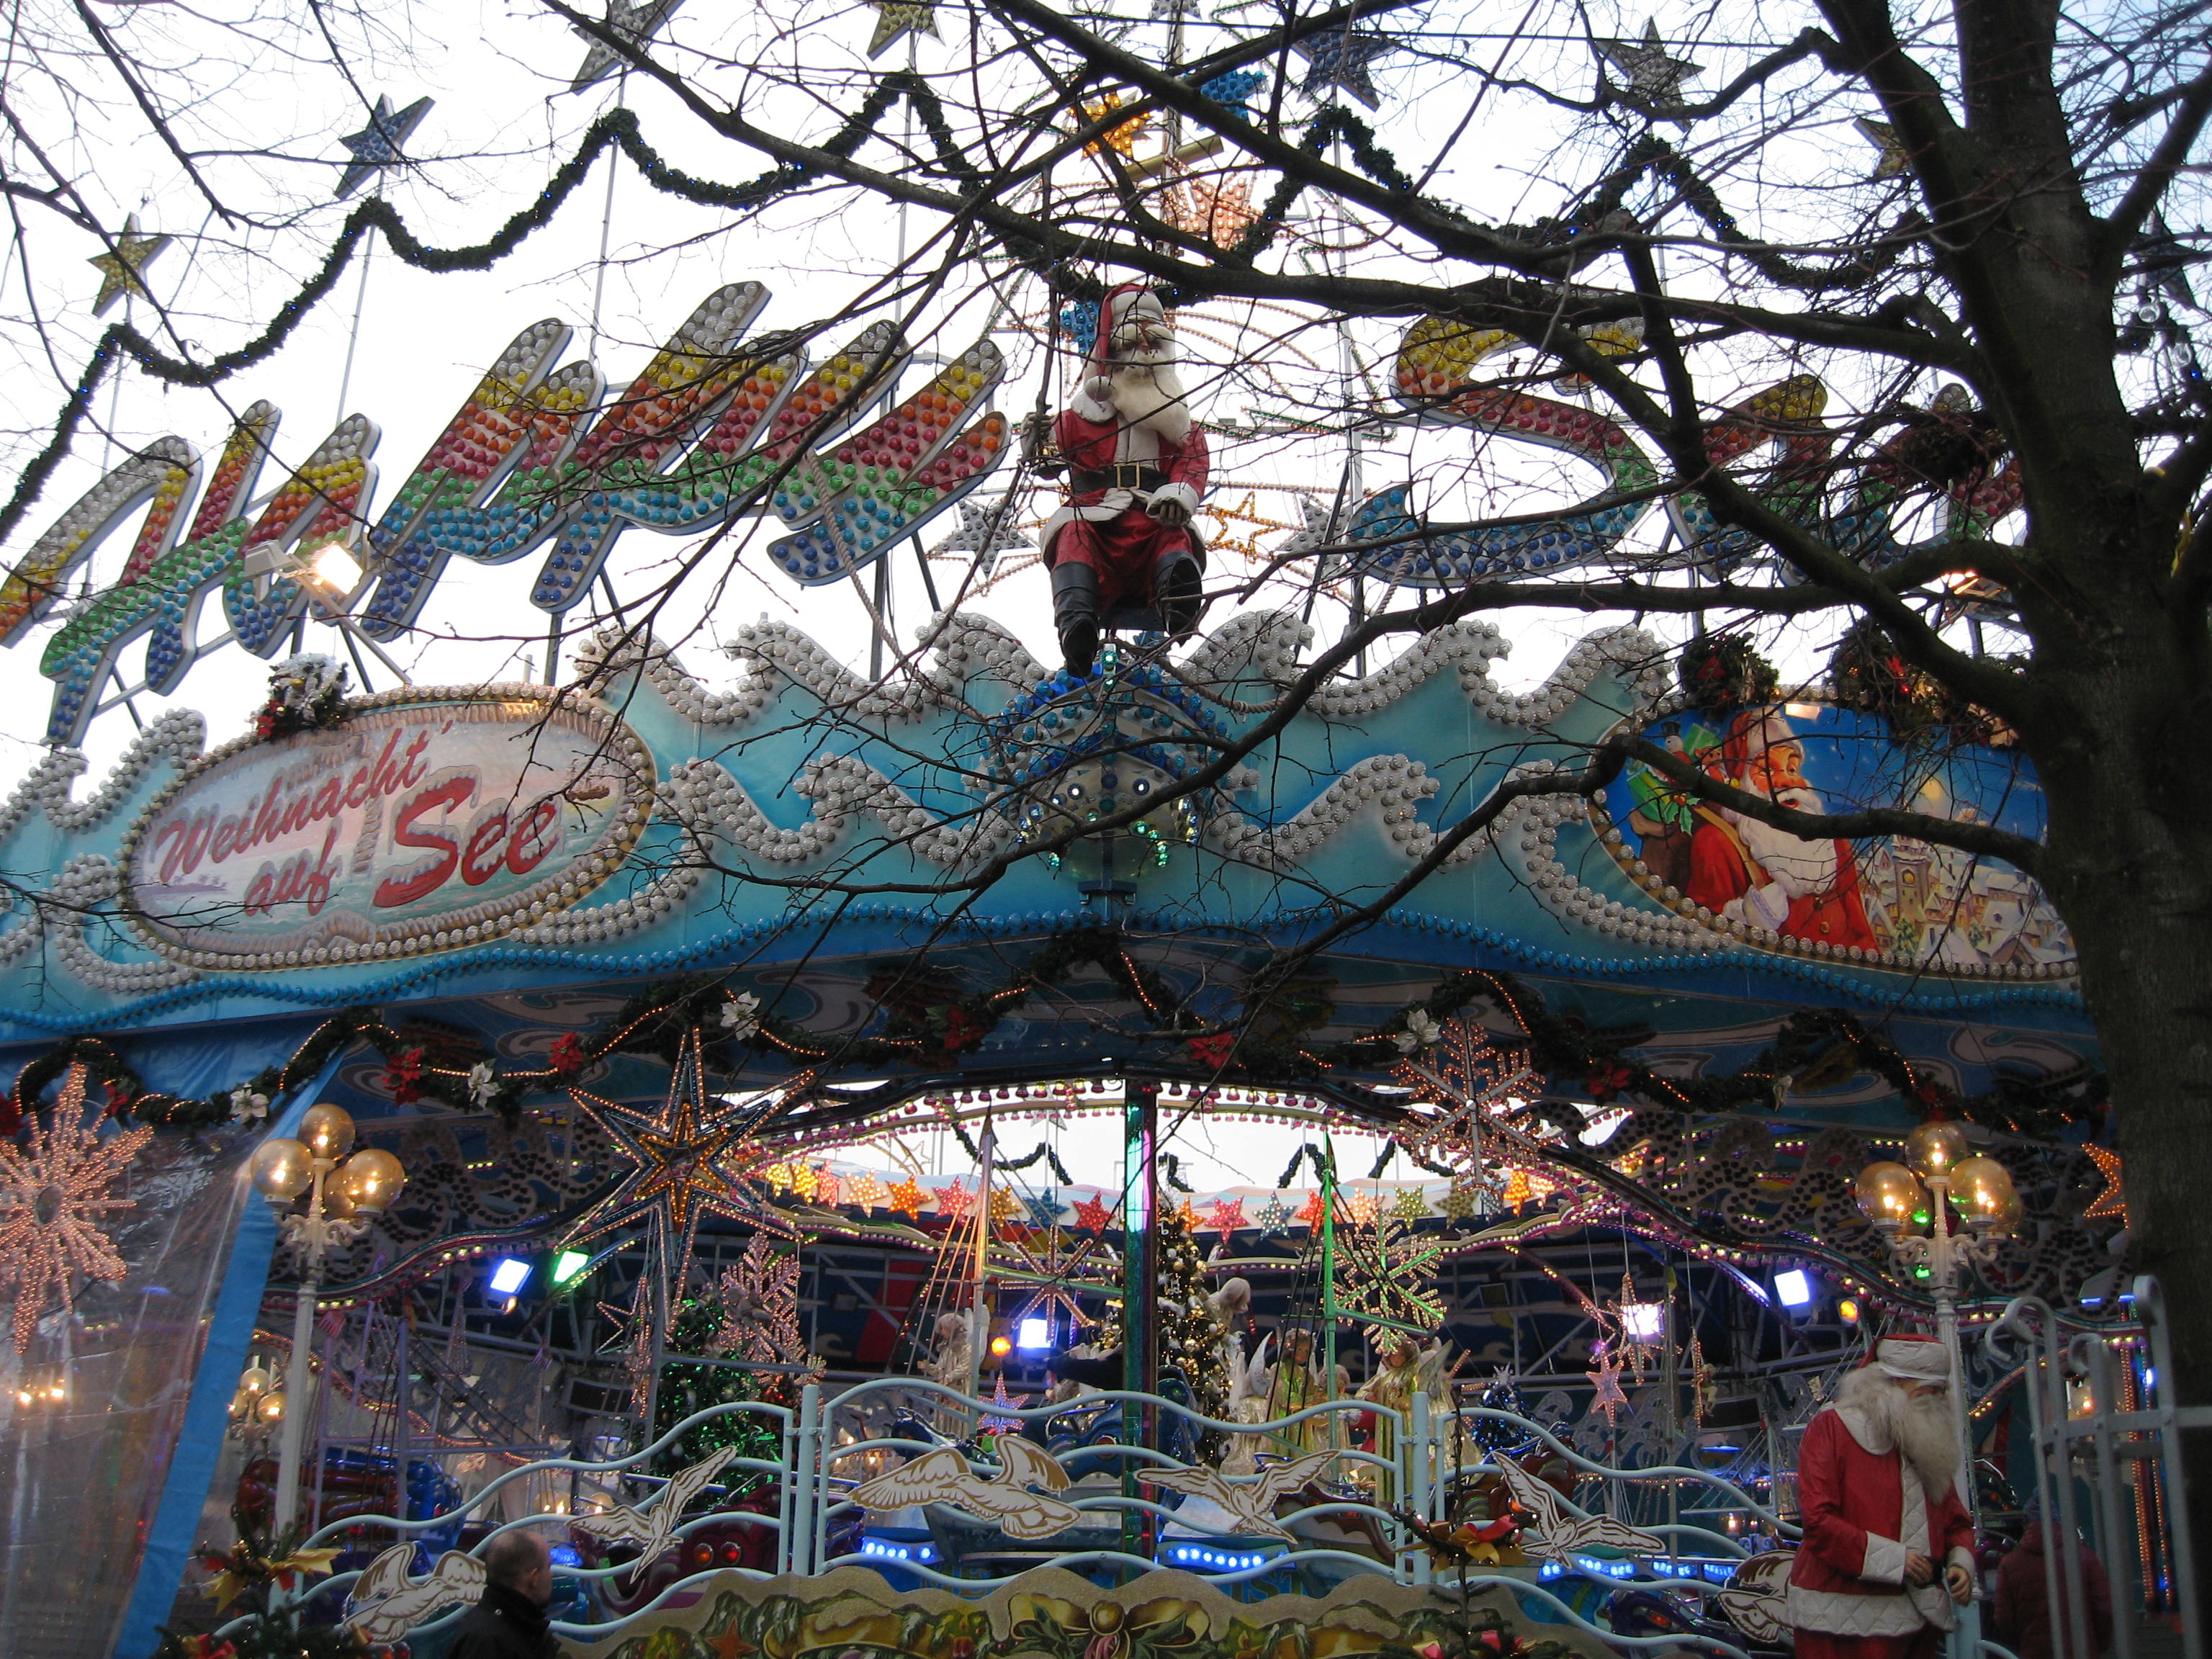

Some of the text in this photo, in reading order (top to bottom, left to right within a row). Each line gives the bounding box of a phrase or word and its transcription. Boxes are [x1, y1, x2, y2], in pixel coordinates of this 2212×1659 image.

[0, 281, 1012, 745] Happy
[244, 768, 562, 917] auf See
